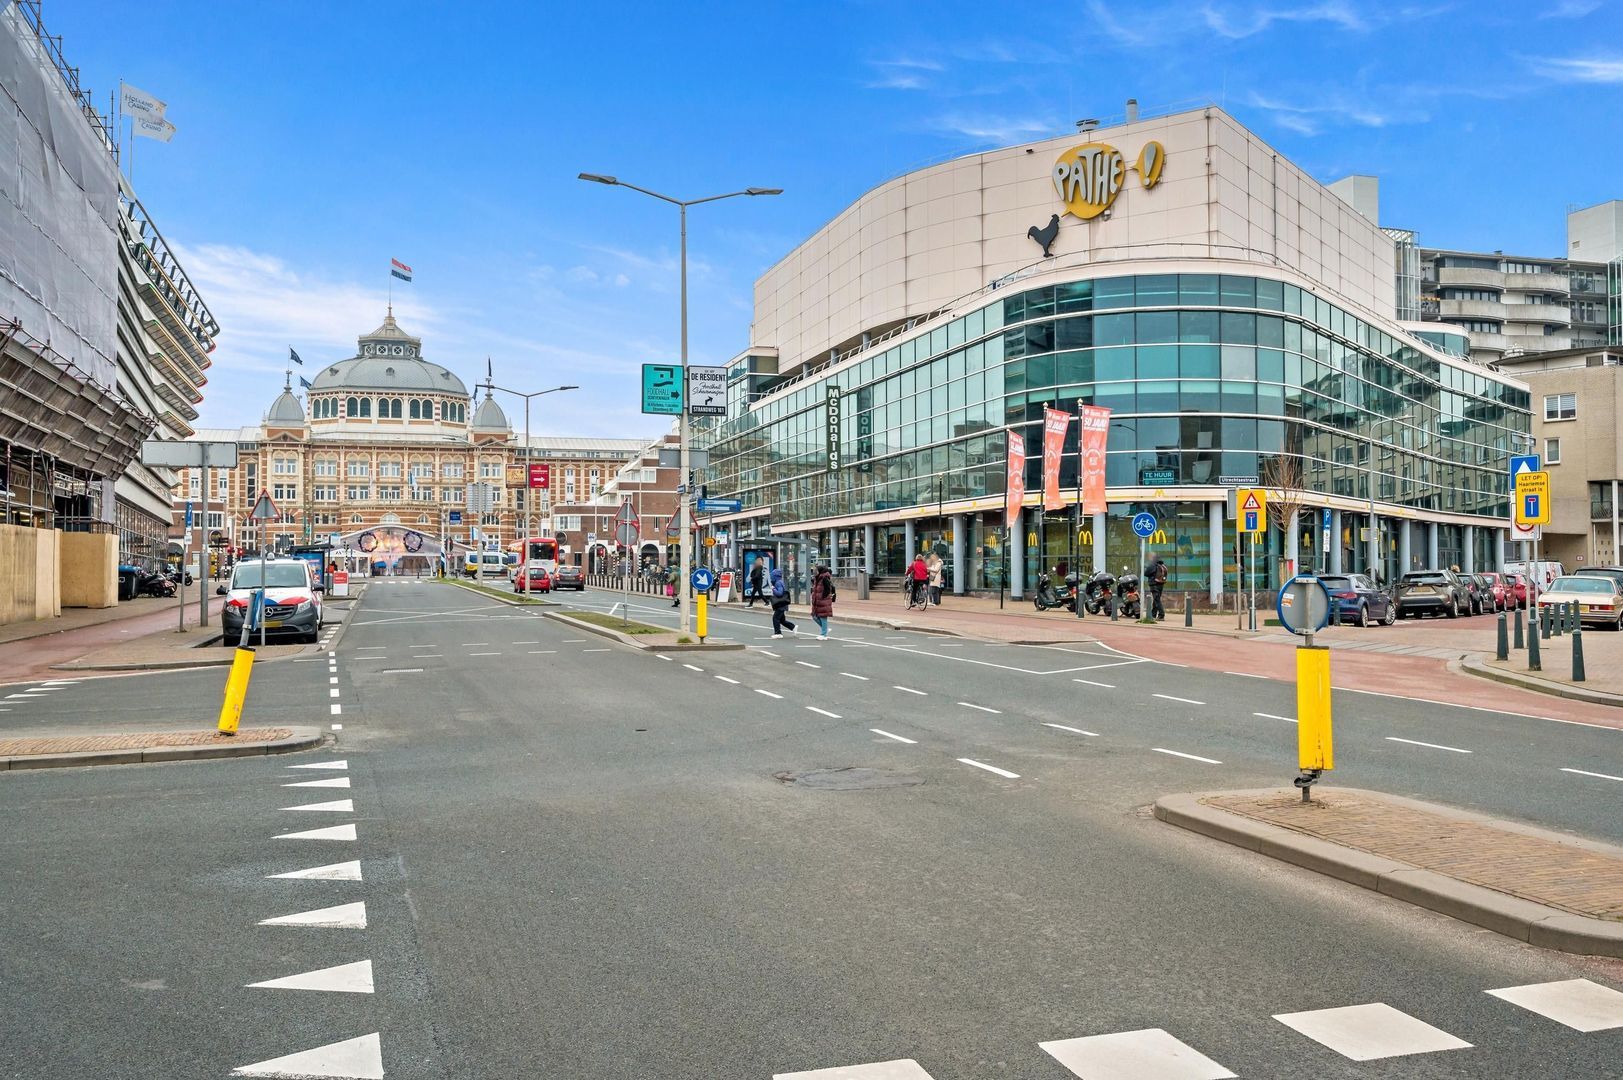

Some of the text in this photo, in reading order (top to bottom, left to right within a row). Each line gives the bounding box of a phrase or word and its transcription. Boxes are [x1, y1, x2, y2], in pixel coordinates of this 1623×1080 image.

[128, 101, 150, 112] CASINO
[141, 122, 162, 132] CASINO
[691, 372, 726, 382] DE RESIDENT
